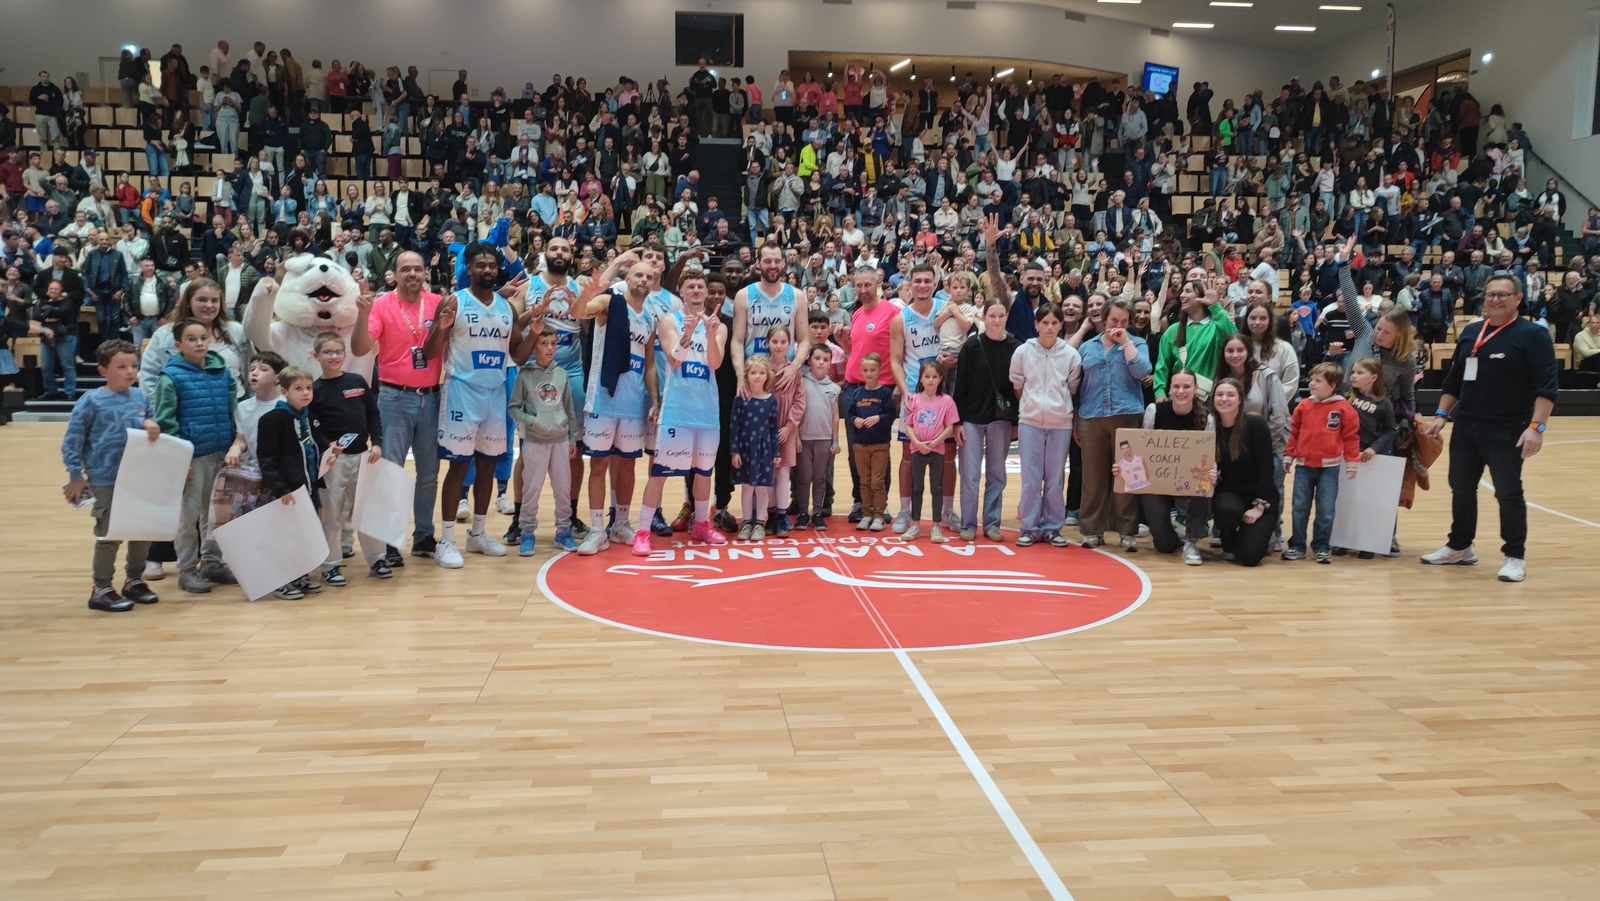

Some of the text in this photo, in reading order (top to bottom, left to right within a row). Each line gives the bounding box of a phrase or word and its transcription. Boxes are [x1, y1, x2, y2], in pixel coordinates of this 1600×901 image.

[751, 305, 761, 314] 11
[465, 313, 479, 324] 12
[910, 327, 918, 336] 4
[912, 335, 940, 348] LAVA
[478, 354, 501, 366] Krys
[630, 359, 642, 370] rys
[686, 363, 706, 377] Kry
[450, 410, 463, 422] 12
[667, 428, 676, 438] 9
[1146, 436, 1190, 449] ALLEZ
[1149, 454, 1181, 464] COACH
[1155, 467, 1171, 479] GG
[644, 544, 1016, 562] LA MAYENNE
